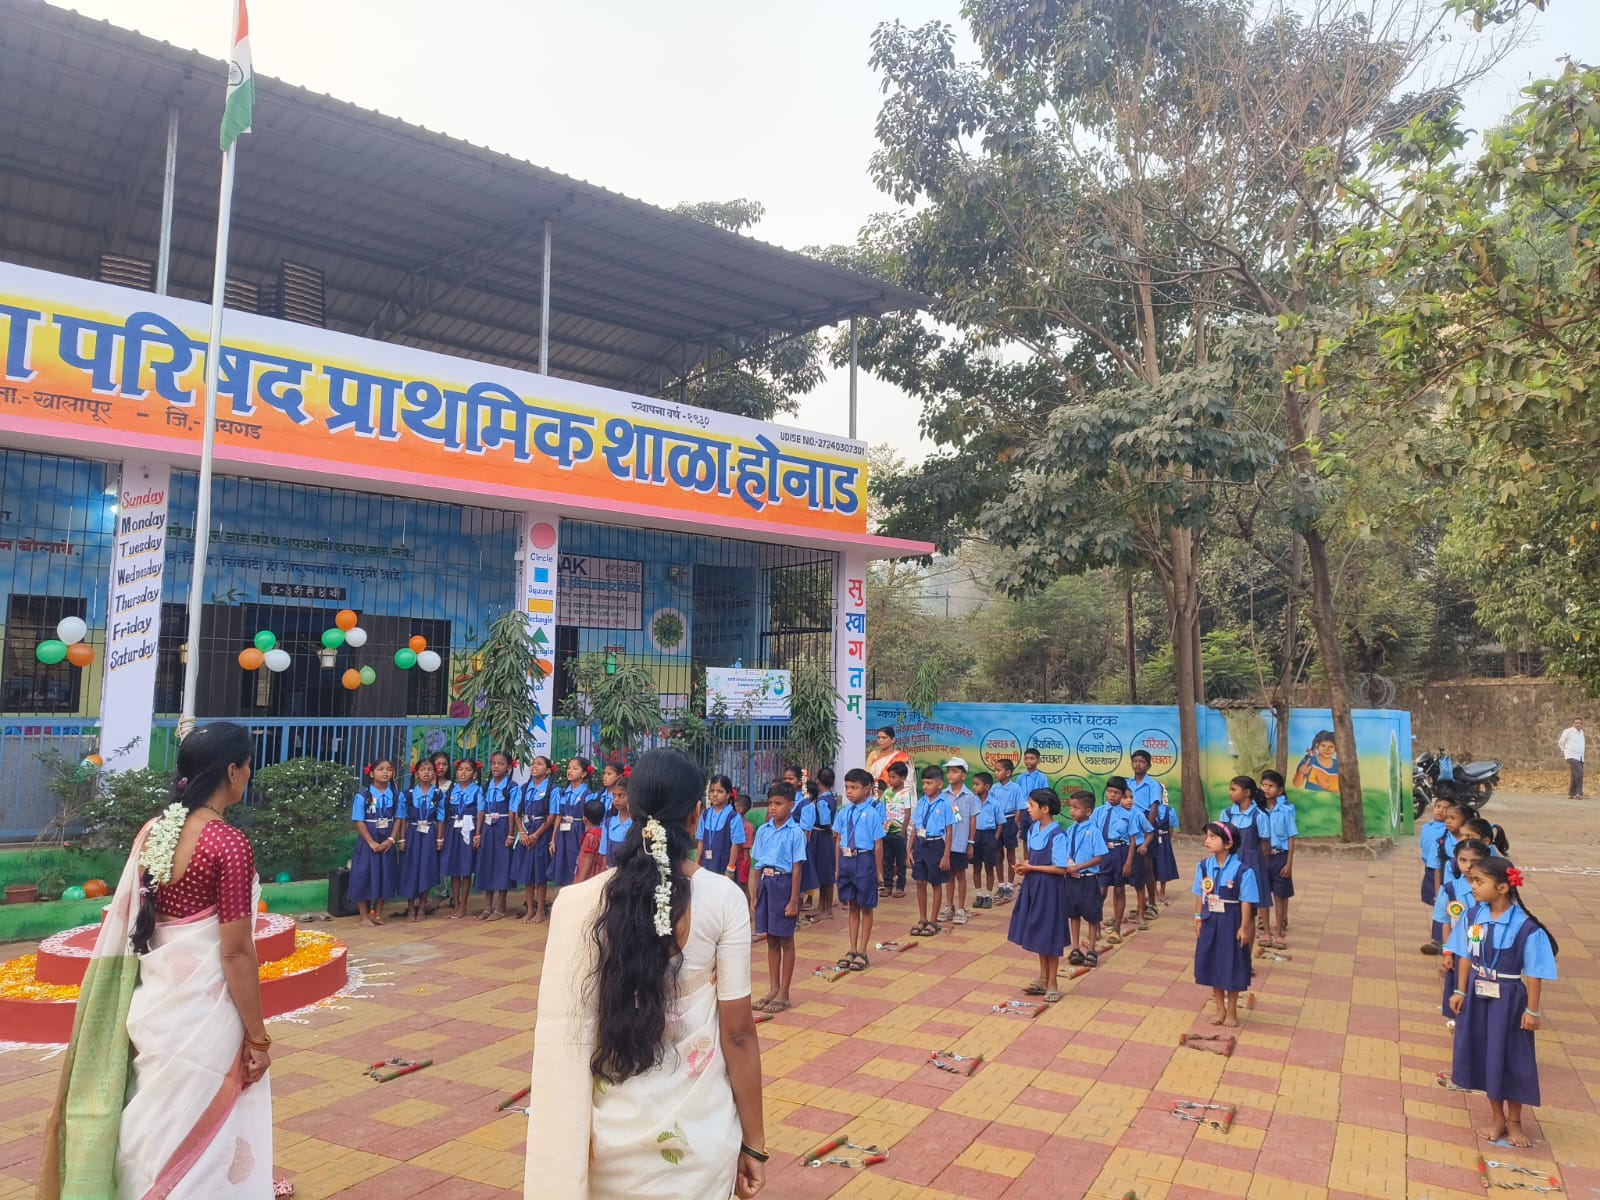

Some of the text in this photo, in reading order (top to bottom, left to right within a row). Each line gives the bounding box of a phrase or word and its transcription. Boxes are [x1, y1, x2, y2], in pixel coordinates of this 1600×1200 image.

[53, 311, 313, 422] परिषद
[322, 365, 597, 469] प्राथमिक
[33, 390, 112, 424] खालापूर
[215, 417, 262, 440] ायगड
[631, 401, 666, 416] स्थापना
[780, 431, 801, 444] UDISE
[121, 490, 164, 509] Sunday
[121, 512, 165, 534] Monday
[120, 535, 162, 558] Tuesday
[530, 553, 553, 563] Circle
[557, 555, 588, 576] AK
[115, 587, 159, 613] Thursday
[528, 585, 553, 596] Square
[113, 615, 152, 642] Friday
[110, 639, 156, 670] Saturday
[1030, 711, 1119, 727] स्वच्छतेचे घटक
[1141, 736, 1168, 750] परिसर
